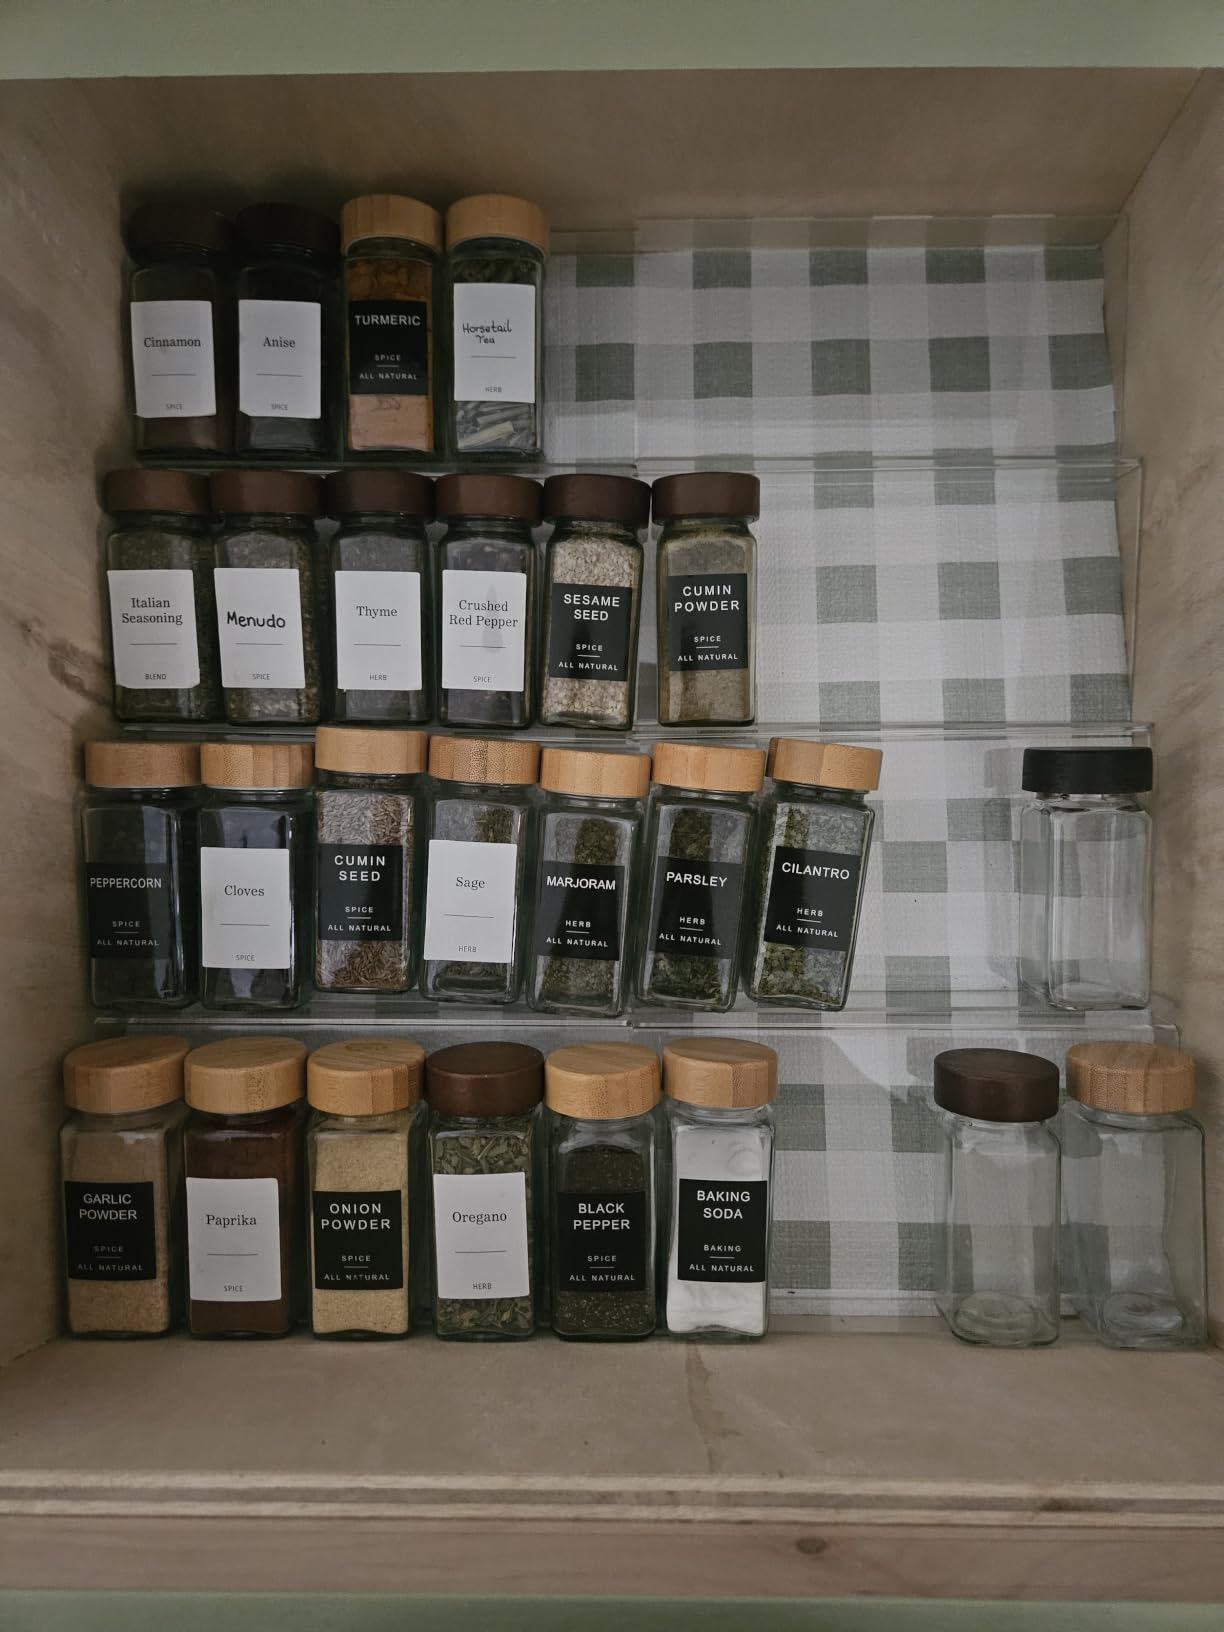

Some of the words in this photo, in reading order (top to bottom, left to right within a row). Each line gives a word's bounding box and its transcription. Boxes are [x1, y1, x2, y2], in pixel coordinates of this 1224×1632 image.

[354, 314, 421, 326] TURMERIC
[462, 320, 512, 334] Horsetail
[143, 336, 201, 348] Cinnamon
[263, 336, 296, 348] Anise
[475, 334, 496, 345] Tea
[166, 403, 183, 411] SPICE
[271, 403, 288, 411] SPICE
[682, 584, 732, 597] CUMIN
[131, 597, 171, 608] Italian
[458, 600, 508, 612] Crushed
[563, 593, 621, 608] SESAME
[674, 600, 740, 613] POWDER
[356, 605, 398, 619] Thyme
[573, 609, 609, 621] SEED
[121, 613, 183, 626] Seasoning
[227, 611, 286, 628] Menudo
[449, 614, 472, 626] Red
[476, 616, 519, 629] Pepper
[693, 635, 721, 643] SPICE
[575, 643, 603, 651] SPICE
[697, 653, 738, 661] NATURAL
[558, 661, 574, 669] ALL
[578, 662, 619, 671] NATURAL
[473, 675, 492, 683] SPICE
[334, 855, 386, 867] CUMIN
[338, 870, 381, 882] SEED
[782, 862, 850, 880] CILANTRO
[90, 877, 162, 889] PEPPERCORN
[455, 876, 485, 890] Sage
[546, 875, 616, 890] MARJORAM
[666, 871, 727, 887] PARSLEY
[224, 884, 265, 897] Cloves
[797, 907, 823, 917] HERB
[112, 920, 140, 928] SPICE
[565, 920, 591, 928] HERB
[679, 916, 706, 925] HERB
[349, 924, 391, 932] NATURAL
[776, 924, 792, 932] ALL
[797, 927, 839, 938] NATURAL
[566, 938, 609, 947] NATURAL
[659, 933, 675, 941] ALL
[680, 935, 722, 945] NATURAL
[235, 954, 255, 962] SPICE
[83, 1193, 132, 1205] GARLIC
[697, 1190, 751, 1202] BAKING
[79, 1209, 138, 1220] POWDER
[329, 1203, 382, 1215] ONION
[578, 1203, 625, 1214] BLACK
[703, 1208, 743, 1219] SODA
[206, 1214, 257, 1228] Paprika
[321, 1218, 391, 1230] POWDER
[452, 1211, 507, 1225] Oregano
[573, 1219, 631, 1230] PEPPER
[93, 1245, 124, 1253] SPICE
[703, 1244, 742, 1252] BAKING
[77, 1263, 94, 1271] ALL
[98, 1264, 144, 1272] NATURAL
[689, 1263, 706, 1271] ALL
[711, 1264, 754, 1272] NATURAL
[591, 1274, 636, 1282] NATURAL
